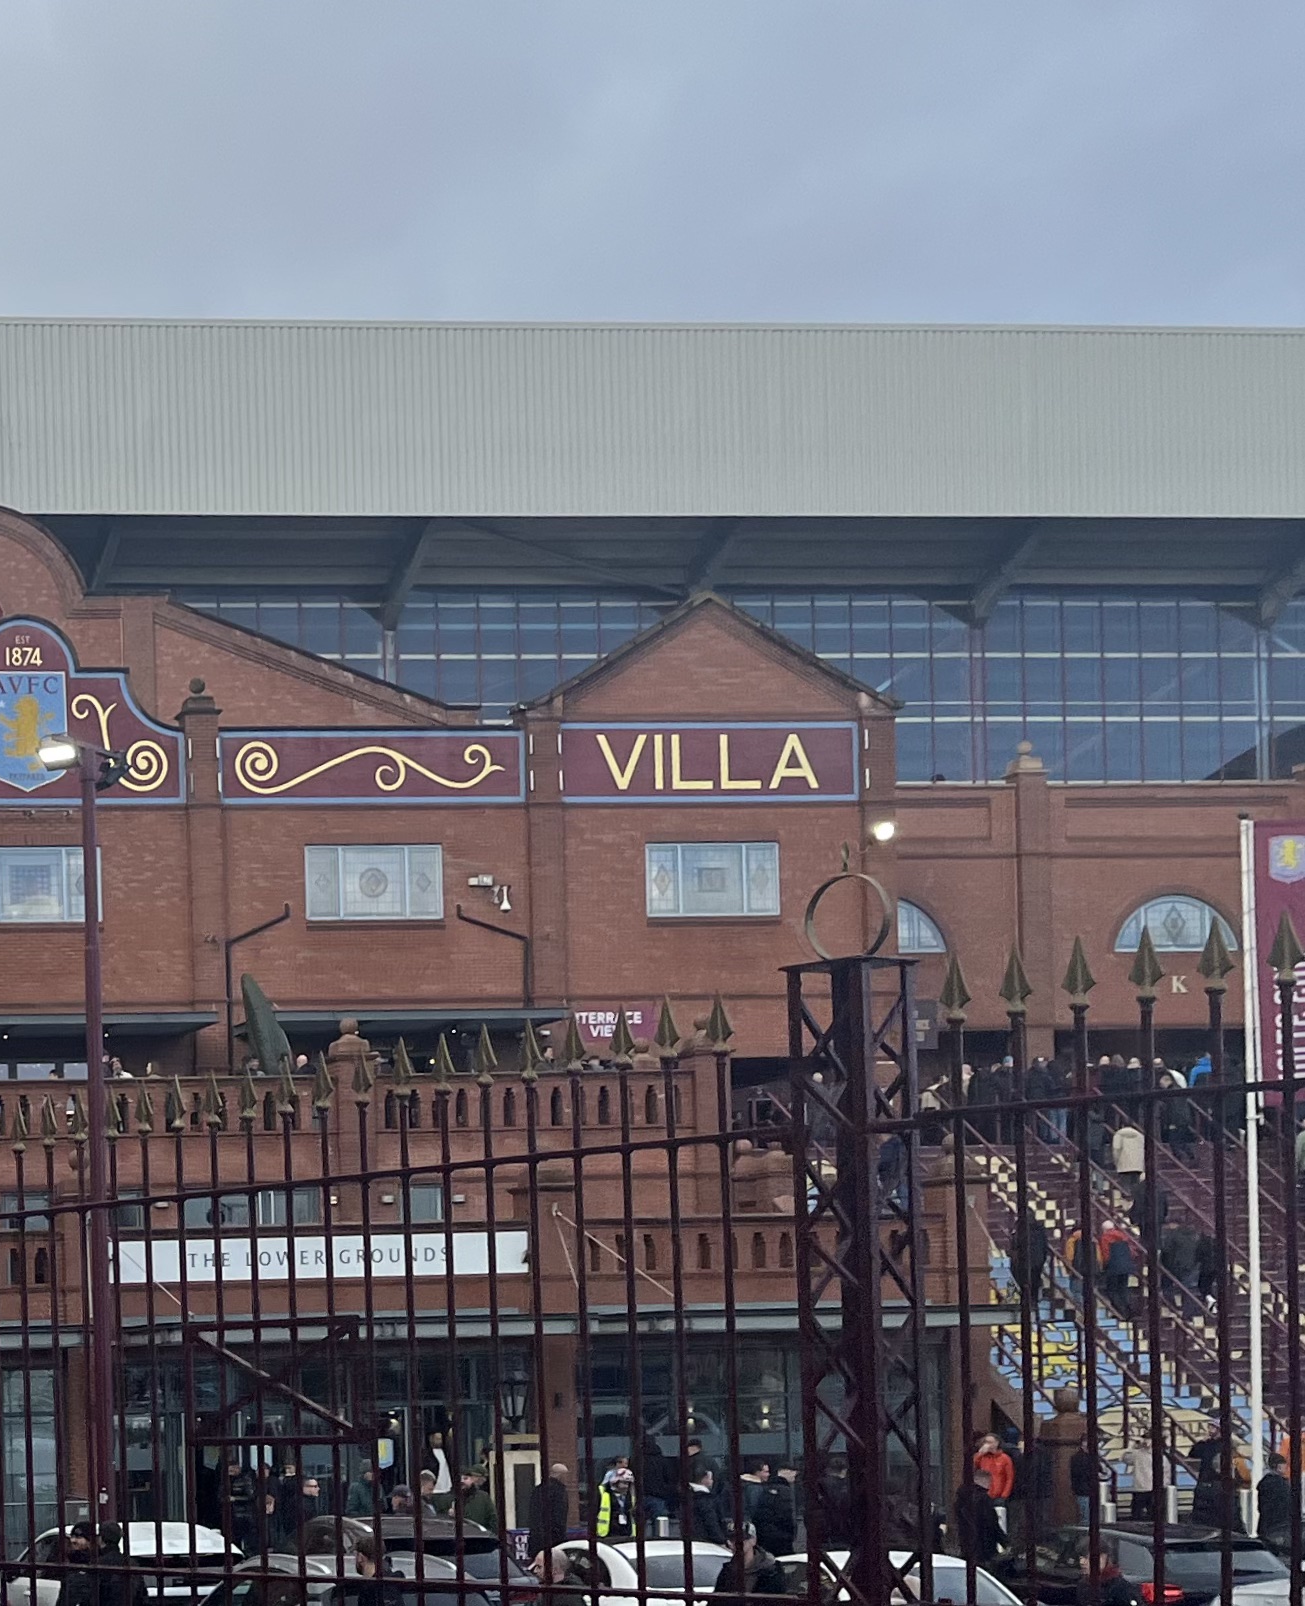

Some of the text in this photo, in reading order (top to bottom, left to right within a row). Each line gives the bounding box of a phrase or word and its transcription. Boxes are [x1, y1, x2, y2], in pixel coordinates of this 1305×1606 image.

[15, 635, 31, 645] EST
[5, 647, 43, 666] 1874
[596, 733, 820, 790] VILLA
[1171, 975, 1189, 993] K
[188, 1252, 231, 1268] THE
[246, 1250, 325, 1267] LOWER
